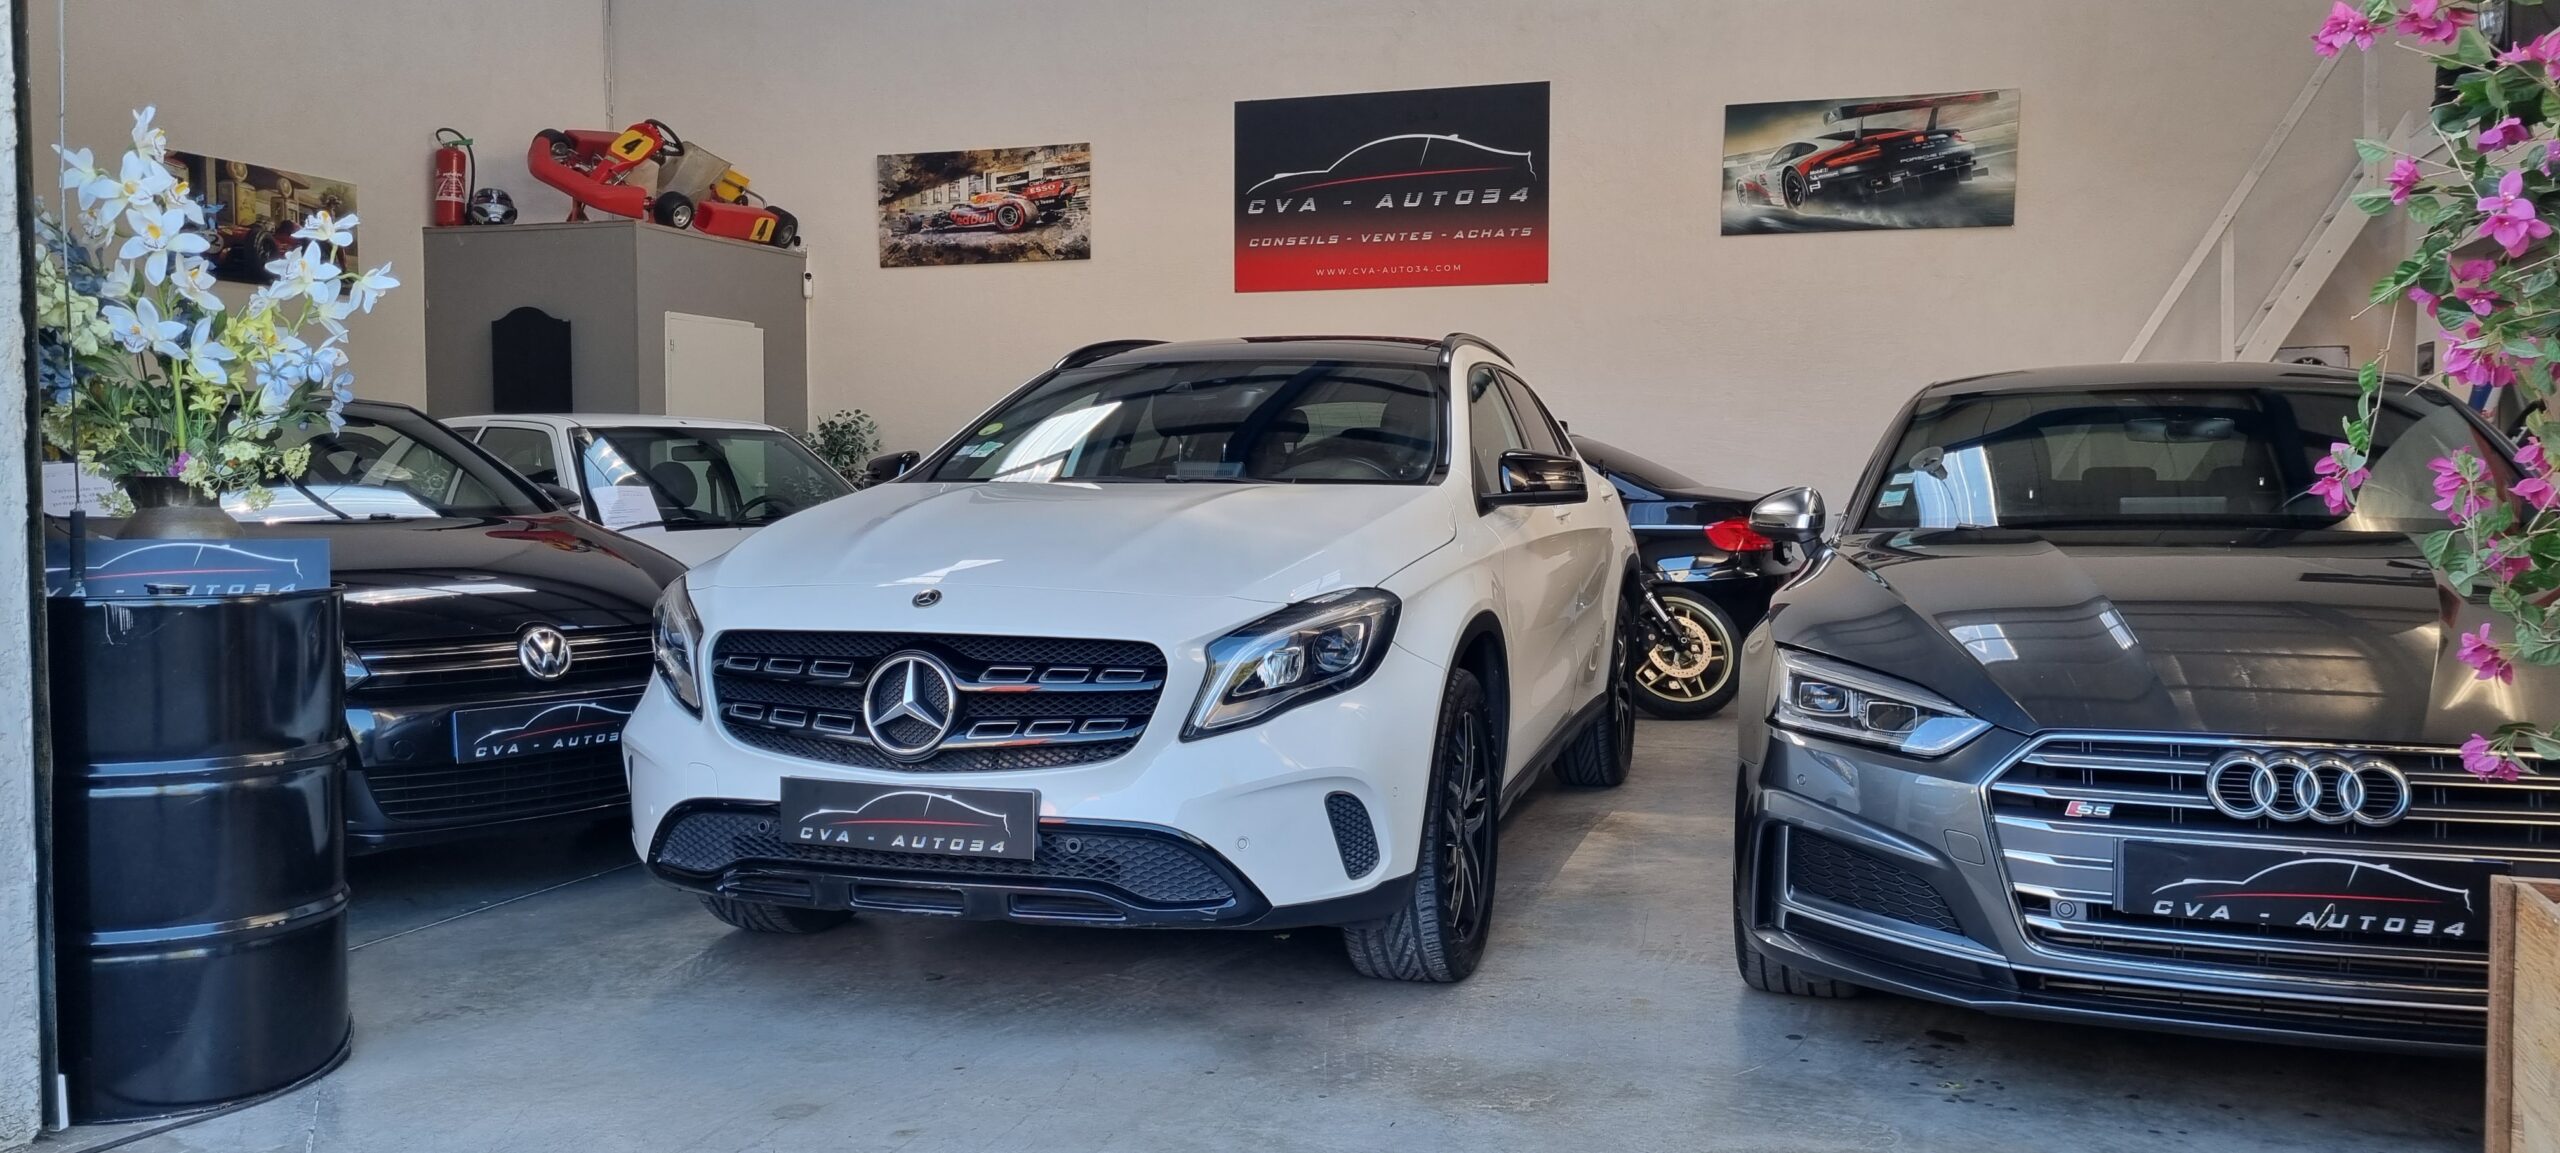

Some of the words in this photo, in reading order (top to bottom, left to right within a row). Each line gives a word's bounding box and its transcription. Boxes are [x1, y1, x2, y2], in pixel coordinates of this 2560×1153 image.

[621, 138, 644, 155] 4
[1030, 184, 1056, 194] ESSO
[1247, 197, 1317, 214] CVA
[1375, 187, 1529, 209] AUTO34
[756, 218, 769, 240] 4
[1249, 235, 1339, 247] CONSEILS
[1361, 232, 1433, 242] VENTES
[1453, 227, 1532, 239] ACHATS
[1316, 264, 1461, 276] WWW.CVA-AUTO34.COM
[476, 743, 519, 757] CVA
[553, 732, 620, 749] AUTO3
[2075, 804, 2112, 816] S5
[800, 826, 849, 842] CVA
[891, 835, 1005, 853] AUTO34
[2153, 900, 2231, 919] CVA
[2296, 911, 2466, 936] AUTO34
